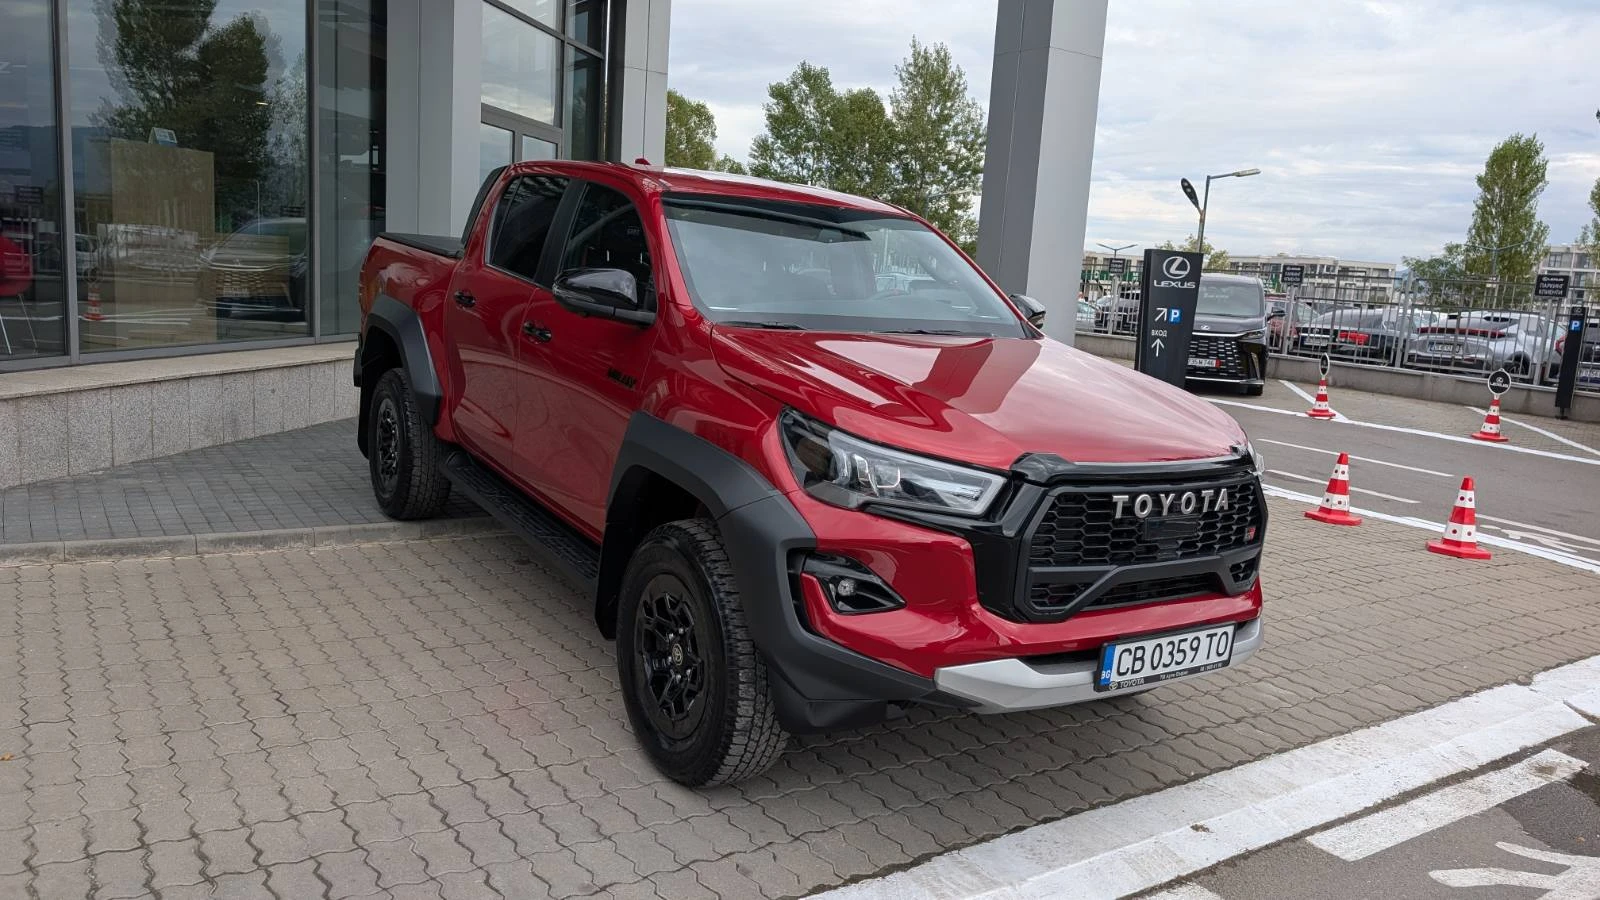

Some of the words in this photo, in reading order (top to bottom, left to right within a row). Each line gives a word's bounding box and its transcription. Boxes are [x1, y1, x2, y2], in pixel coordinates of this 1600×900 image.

[1153, 279, 1196, 289] LEXUS
[1170, 309, 1180, 322] P
[1151, 329, 1168, 338] ВХОД
[1112, 488, 1229, 519] TOYOTA
[1116, 645, 1146, 676] CB
[1150, 636, 1201, 671] 0359
[1206, 631, 1229, 660] TO
[1101, 669, 1111, 679] BG
[1119, 678, 1145, 688] TOYOTA
